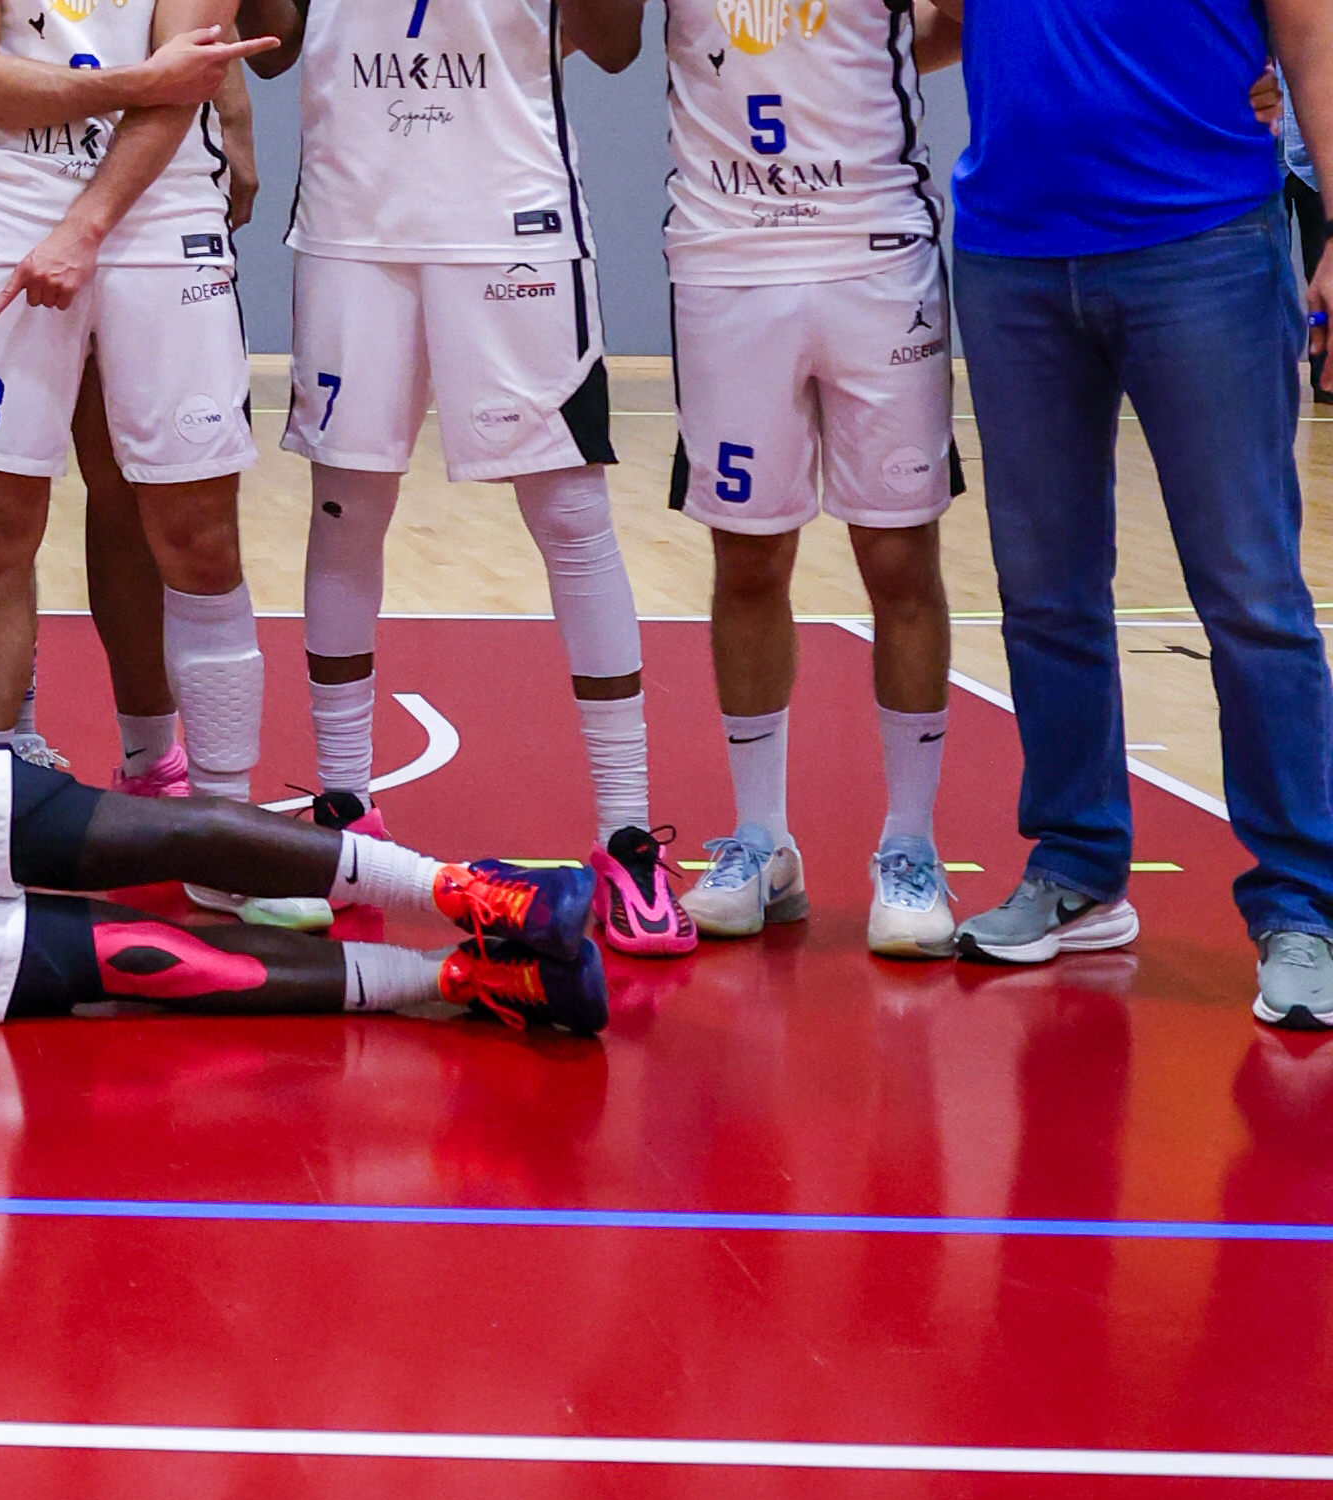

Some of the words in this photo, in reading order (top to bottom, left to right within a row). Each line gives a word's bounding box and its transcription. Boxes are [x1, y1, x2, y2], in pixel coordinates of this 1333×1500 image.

[746, 94, 787, 155] 5
[317, 373, 342, 432] 7
[717, 442, 754, 503] 5
